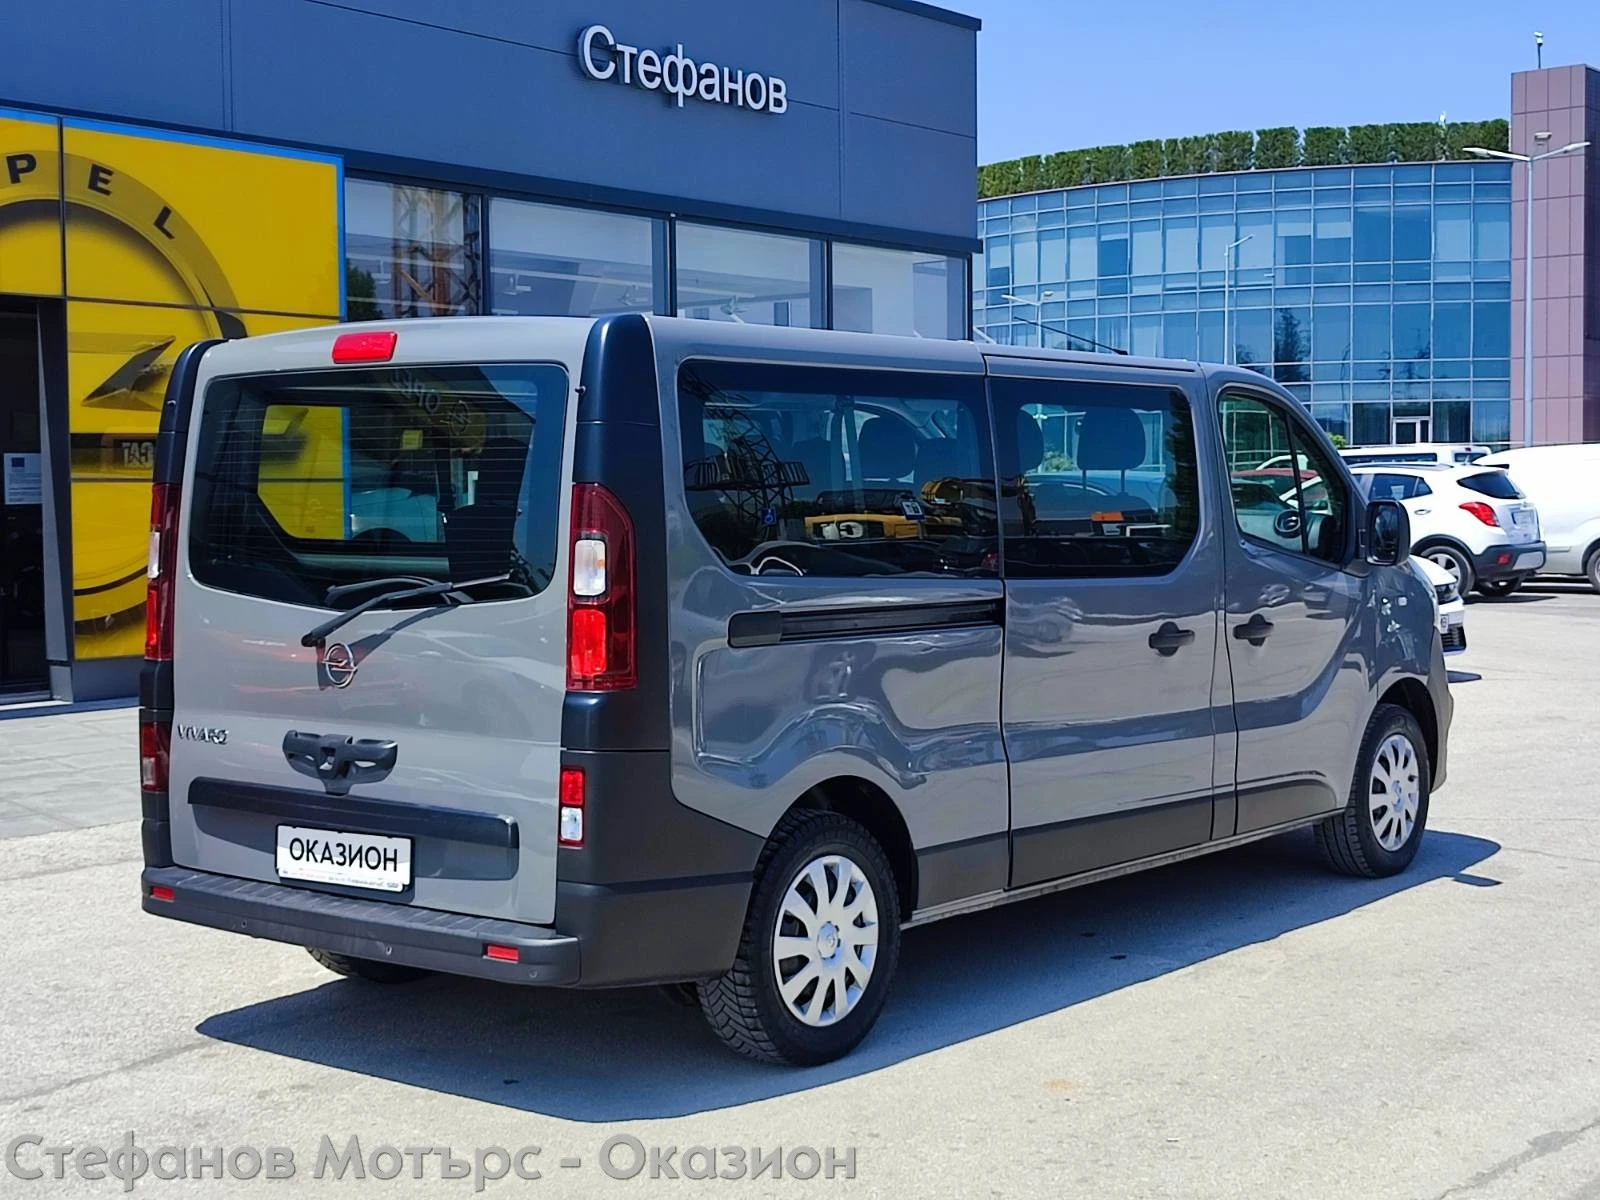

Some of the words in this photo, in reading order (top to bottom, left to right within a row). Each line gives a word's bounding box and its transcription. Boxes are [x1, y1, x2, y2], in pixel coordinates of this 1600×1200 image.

[580, 24, 788, 114] Стефанов
[177, 724, 230, 746] VIVARO
[288, 837, 398, 873] ОКАЗИОН
